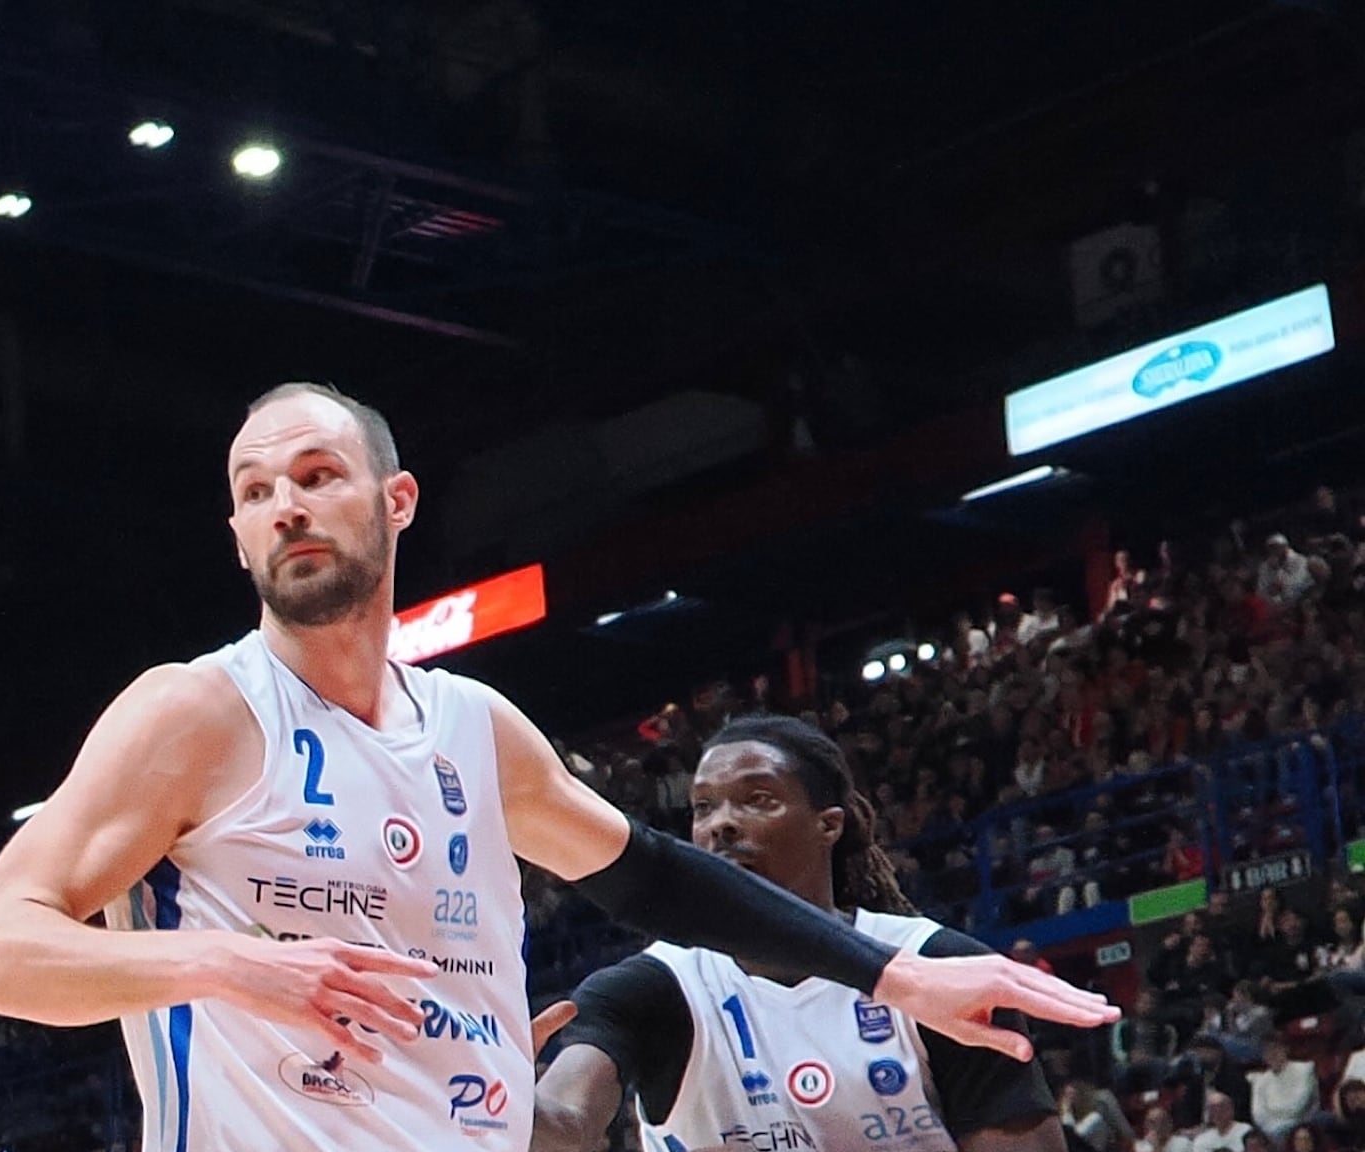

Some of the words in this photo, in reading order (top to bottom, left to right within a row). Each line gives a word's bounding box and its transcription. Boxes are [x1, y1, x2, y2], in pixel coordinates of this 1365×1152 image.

[294, 728, 334, 806] 2
[247, 876, 387, 920] TECHNE
[433, 888, 478, 927] a2a
[431, 955, 494, 976] MININI
[722, 994, 755, 1059] 1
[860, 1104, 941, 1141] a2a
